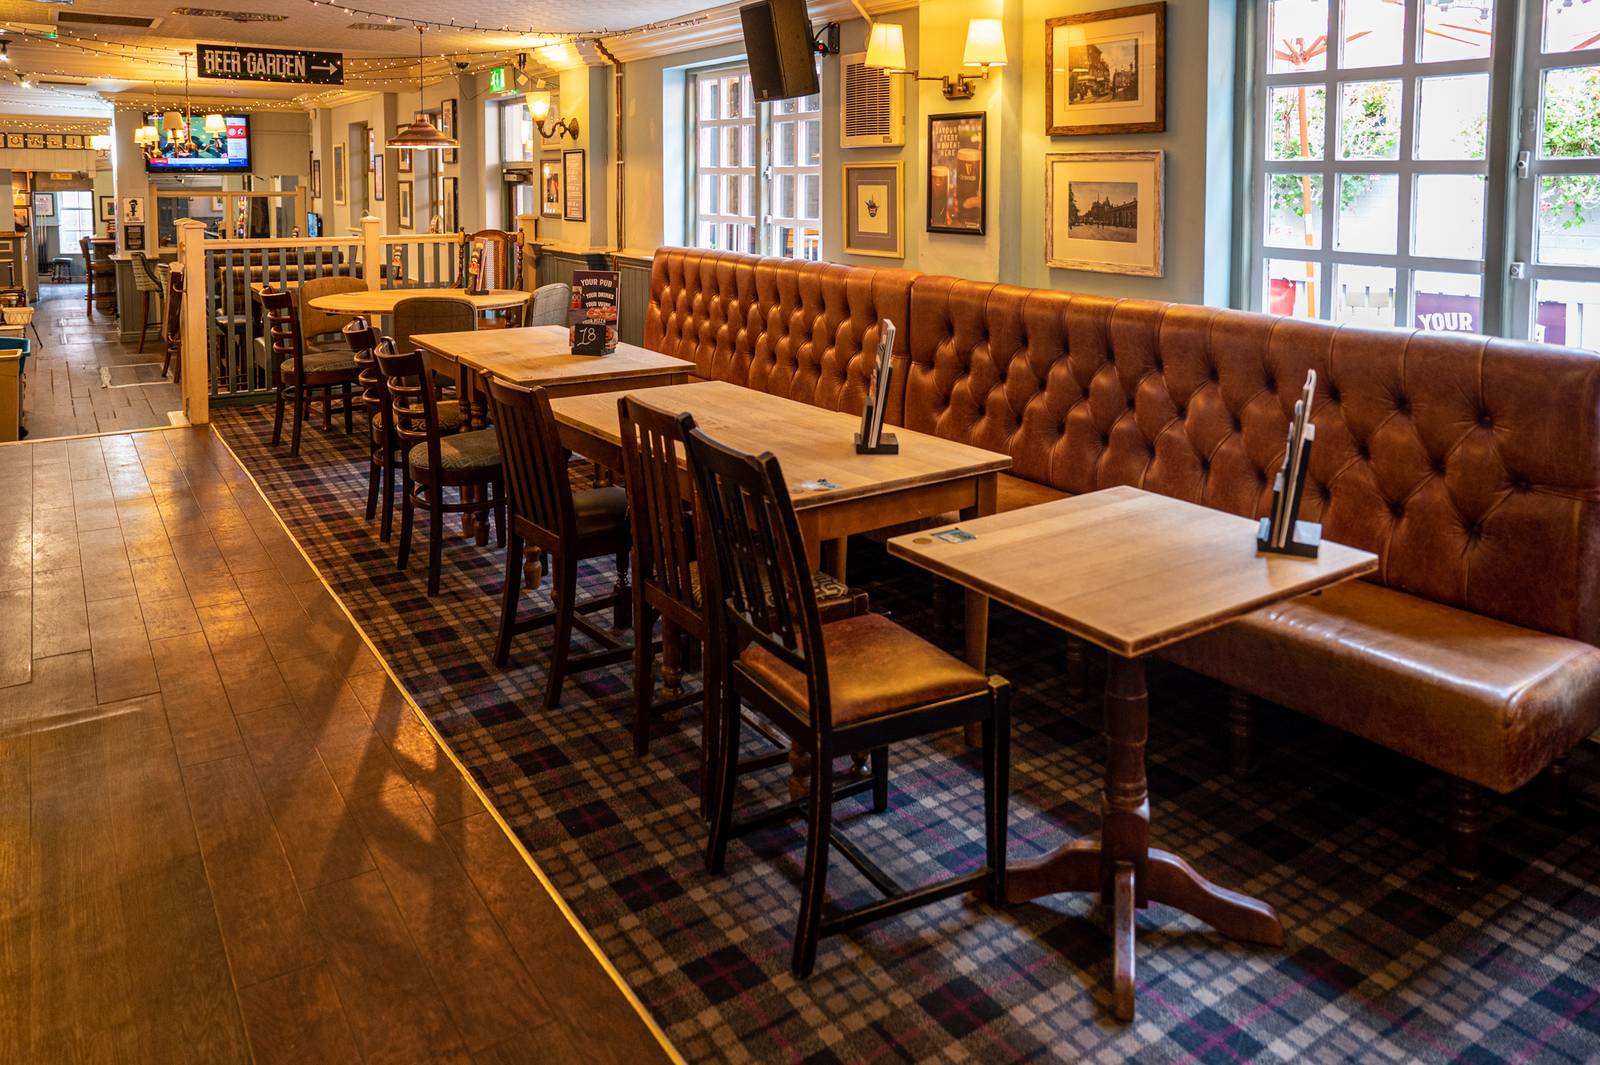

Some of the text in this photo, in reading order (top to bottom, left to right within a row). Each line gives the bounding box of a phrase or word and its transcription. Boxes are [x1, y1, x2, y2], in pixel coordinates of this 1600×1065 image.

[204, 49, 306, 77] BEER GARDEN
[599, 279, 613, 288] PUB
[1417, 312, 1473, 332] YOUR
[577, 327, 597, 347] 18
